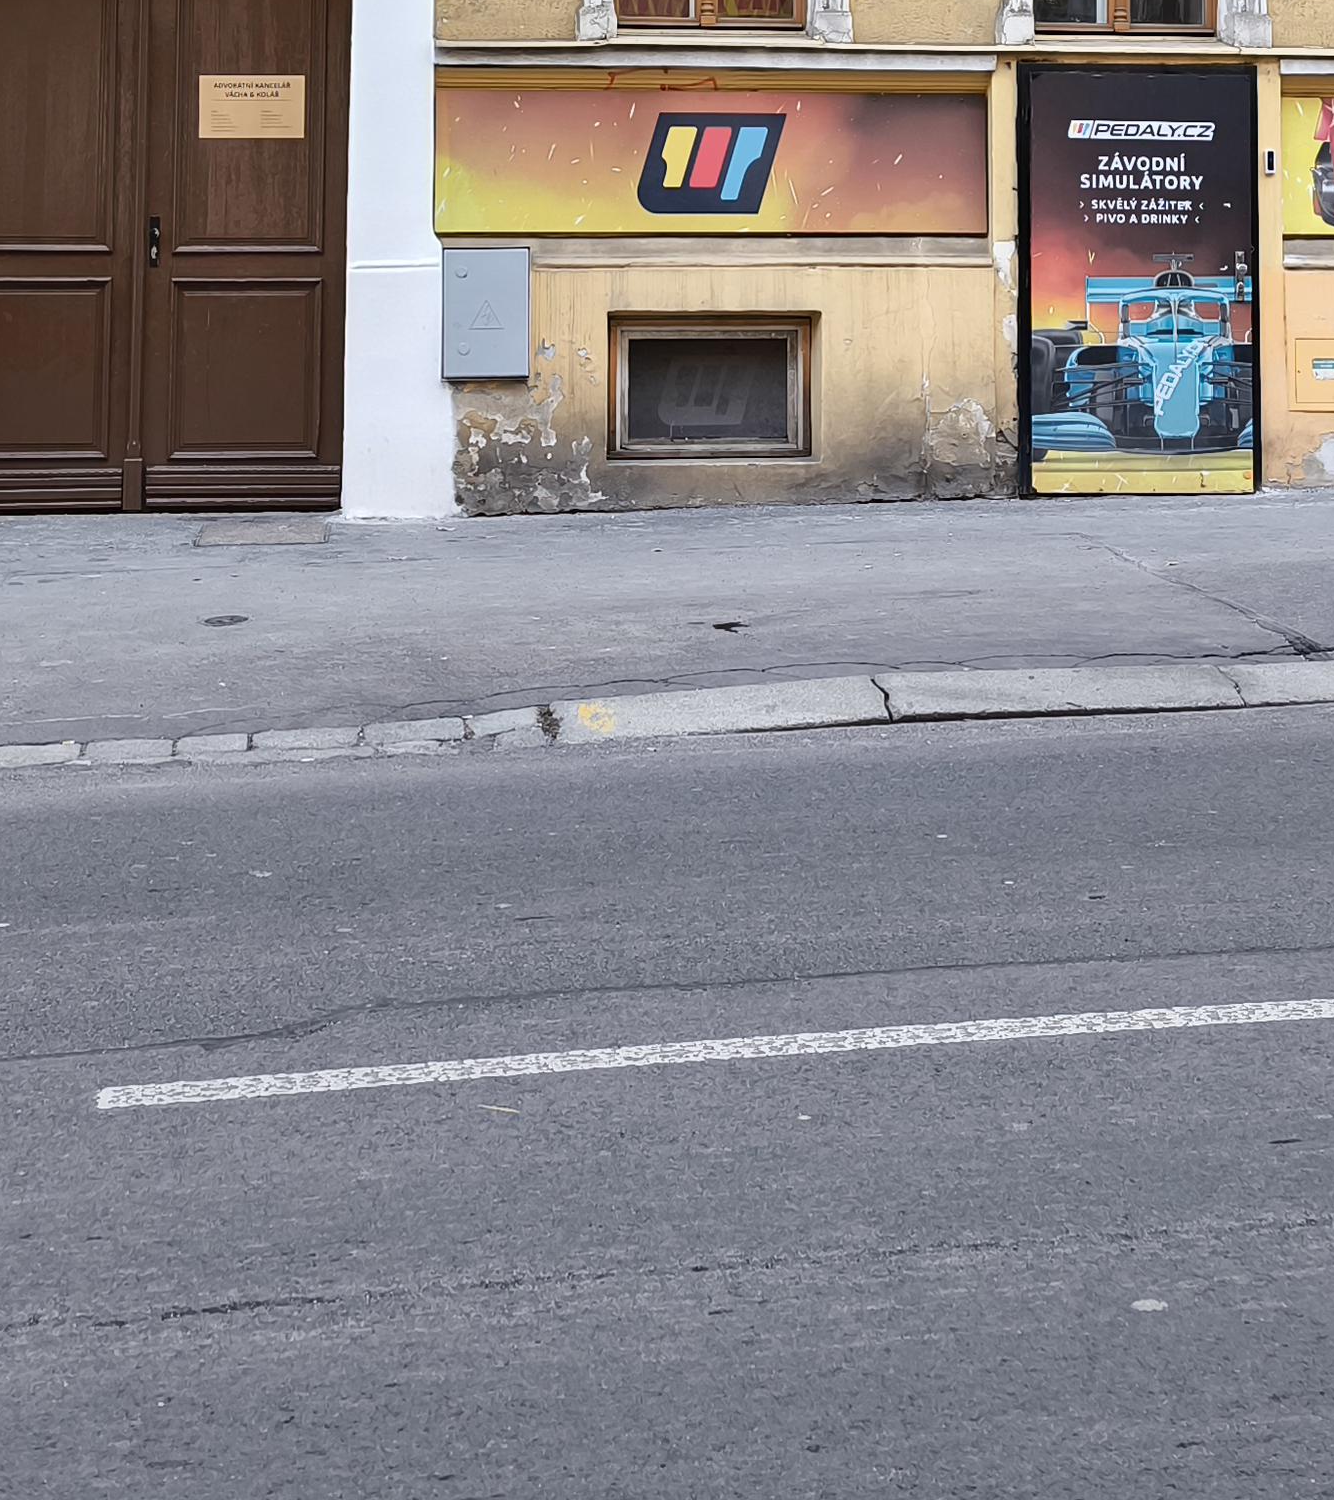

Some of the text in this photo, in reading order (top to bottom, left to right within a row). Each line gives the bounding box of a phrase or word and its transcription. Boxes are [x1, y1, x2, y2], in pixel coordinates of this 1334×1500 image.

[1094, 123, 1213, 138] PEDALY.CZ
[1097, 152, 1186, 172] ZÁVODNÍ
[1080, 171, 1204, 190] SIMULÁTORY
[1091, 197, 1193, 211] SKVĚLÝ ZÁŽITEK
[1096, 213, 1189, 225] PIVO A DRINKY
